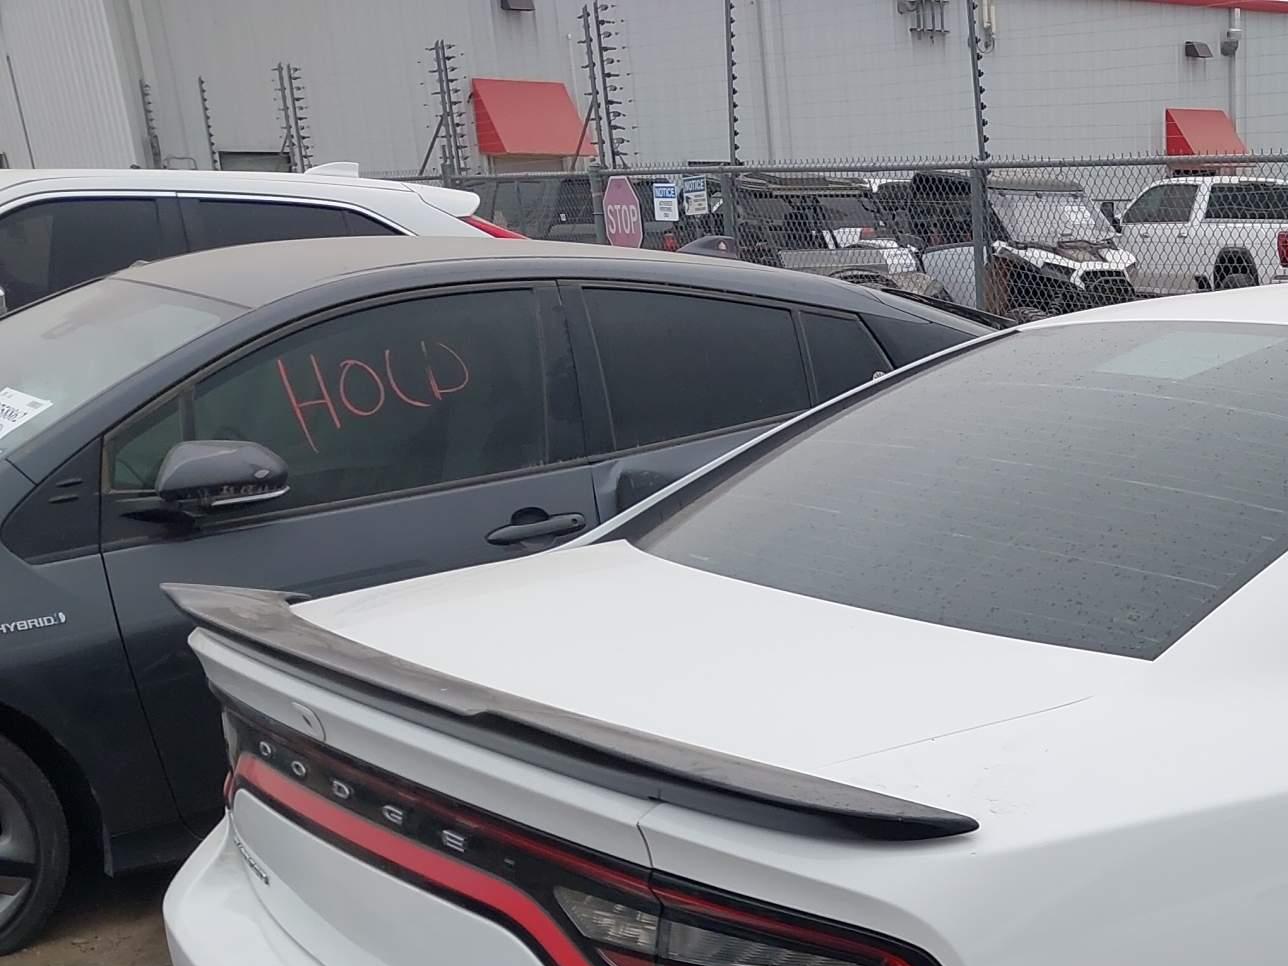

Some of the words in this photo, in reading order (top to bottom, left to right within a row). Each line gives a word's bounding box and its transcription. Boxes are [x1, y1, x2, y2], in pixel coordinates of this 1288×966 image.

[655, 187, 675, 197] NOTICE
[685, 179, 704, 191] NOTICE
[607, 204, 639, 235] STOP
[259, 741, 466, 853] DODGE
